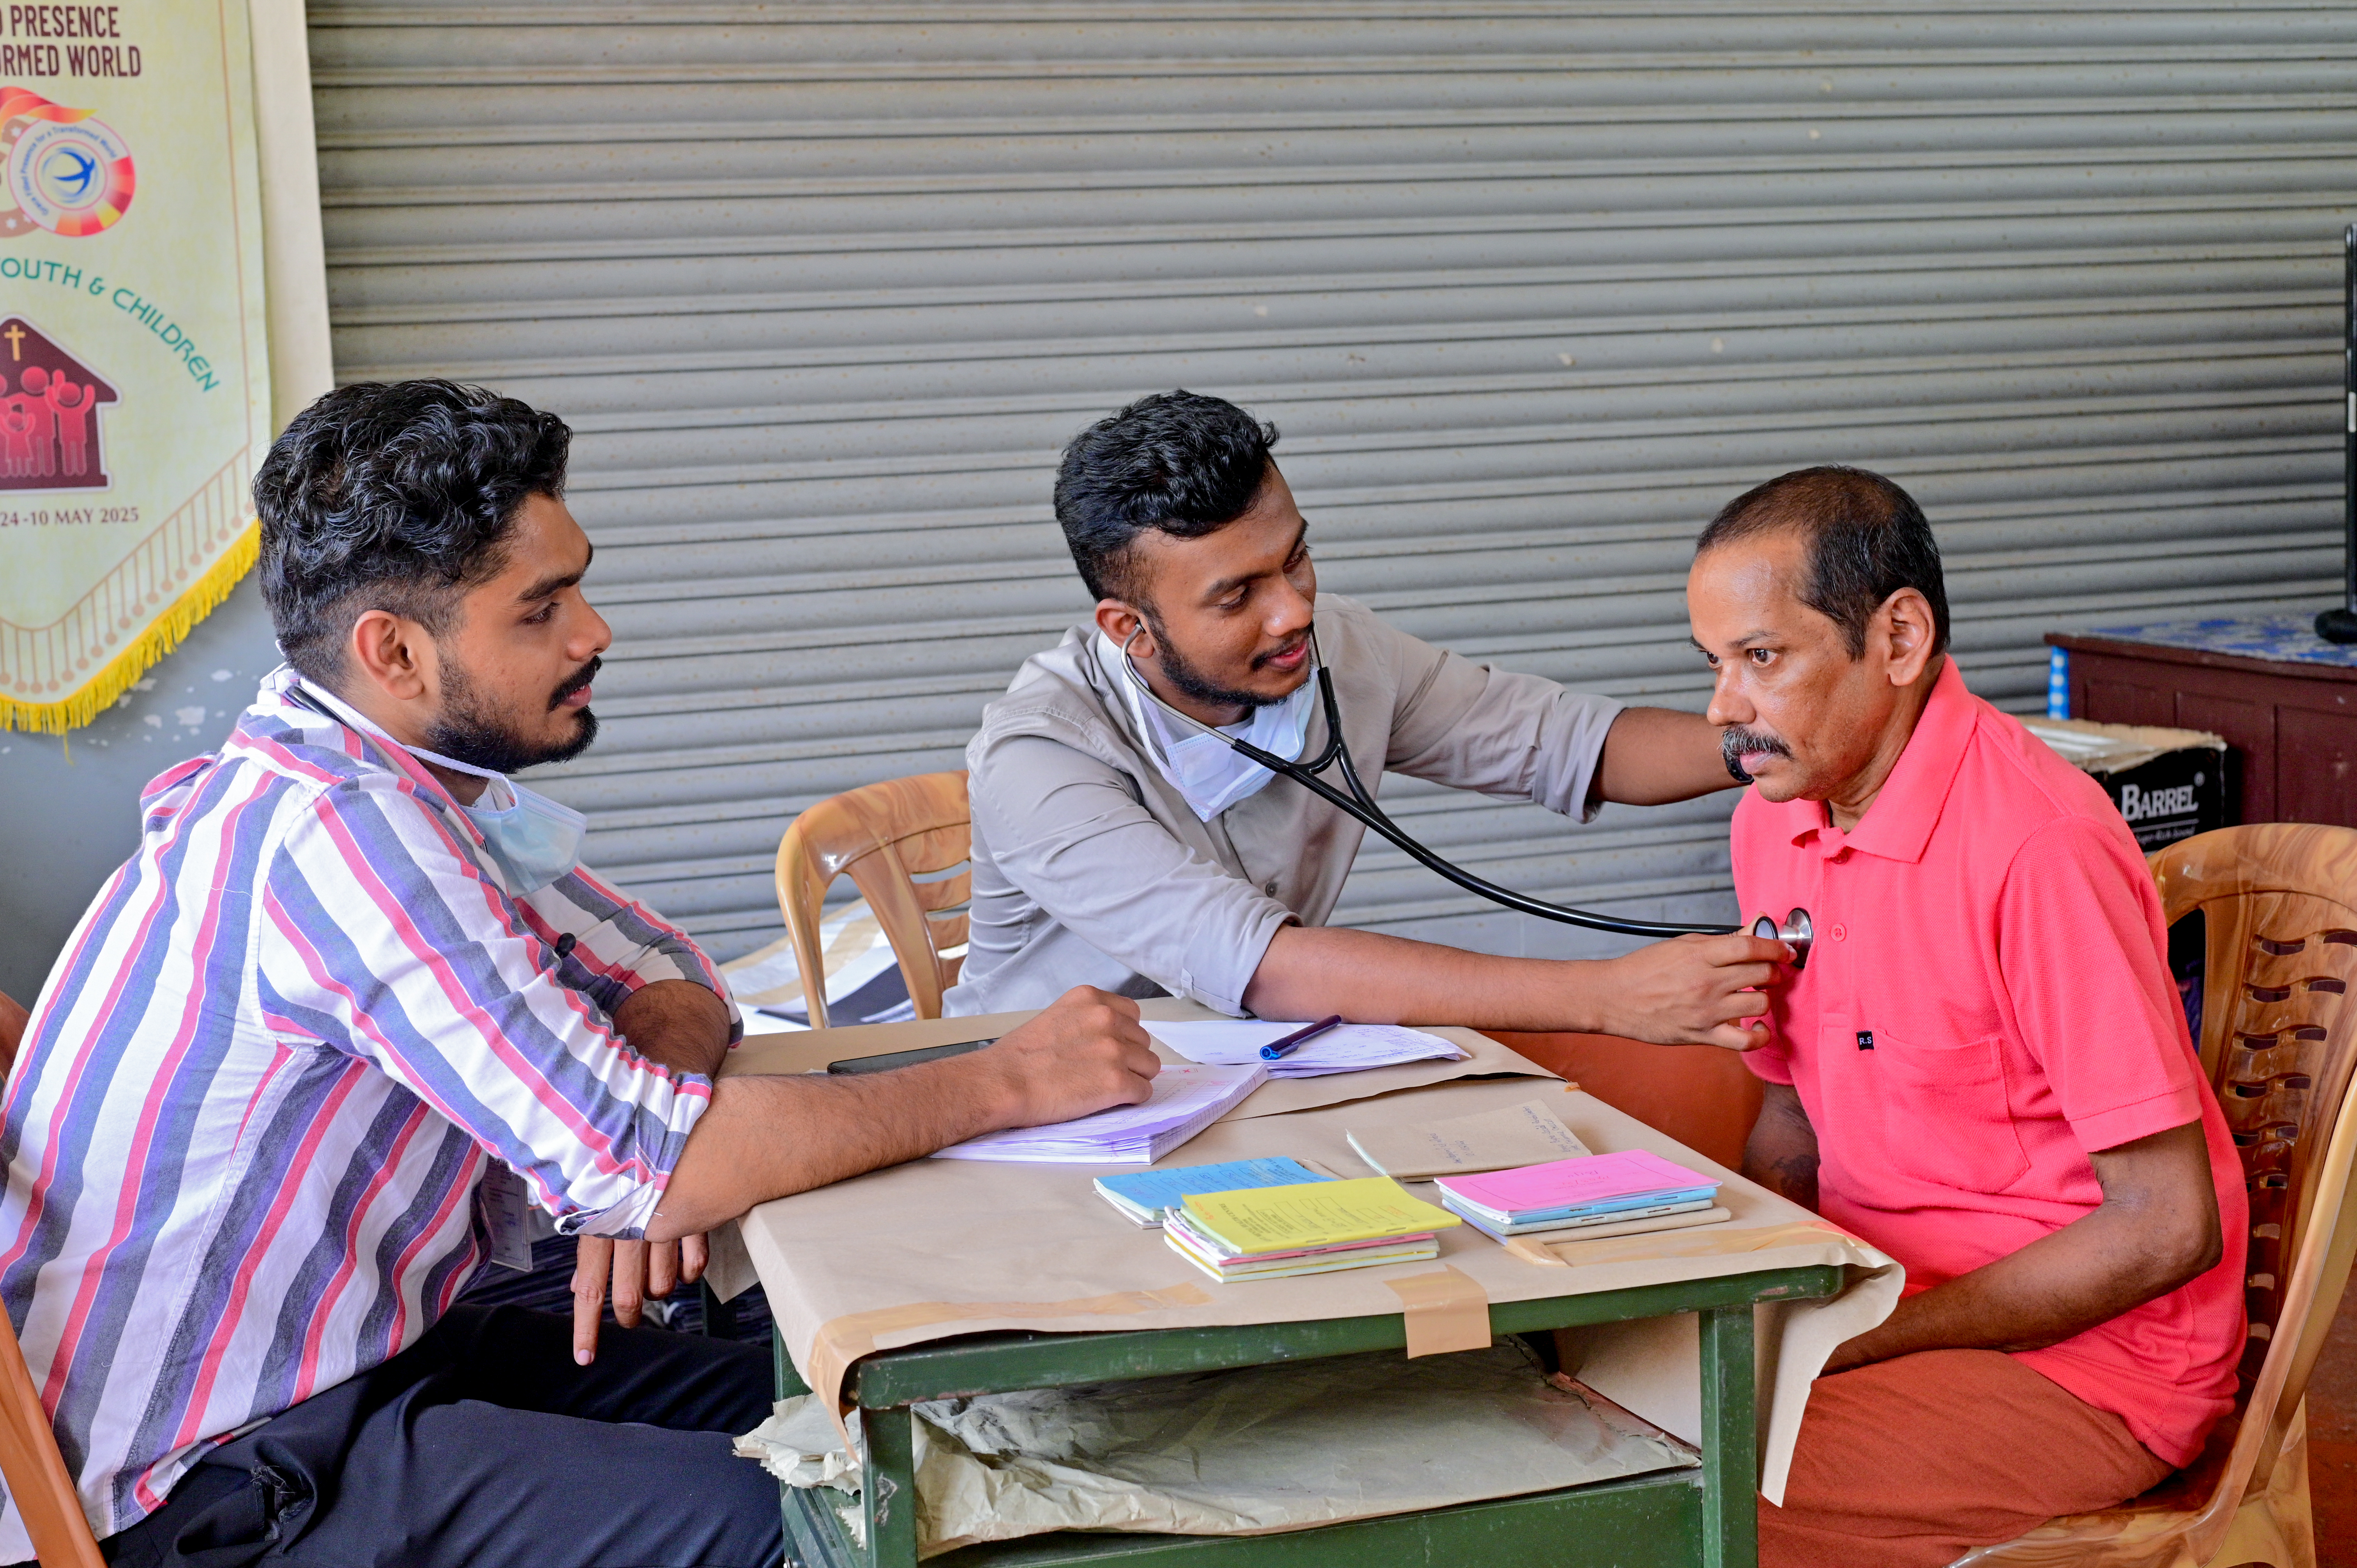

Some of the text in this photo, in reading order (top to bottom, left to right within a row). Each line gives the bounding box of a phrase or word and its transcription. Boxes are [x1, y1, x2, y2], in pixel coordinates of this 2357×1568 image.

[10, 5, 120, 37] PRESENCE
[0, 44, 141, 77] RMED WORLD
[0, 255, 221, 392] OUTH & CHILDREN
[55, 508, 94, 524] MAY
[99, 506, 140, 523] 2025
[2121, 783, 2199, 822] BARREL
[1859, 1036, 1872, 1045] R.S
